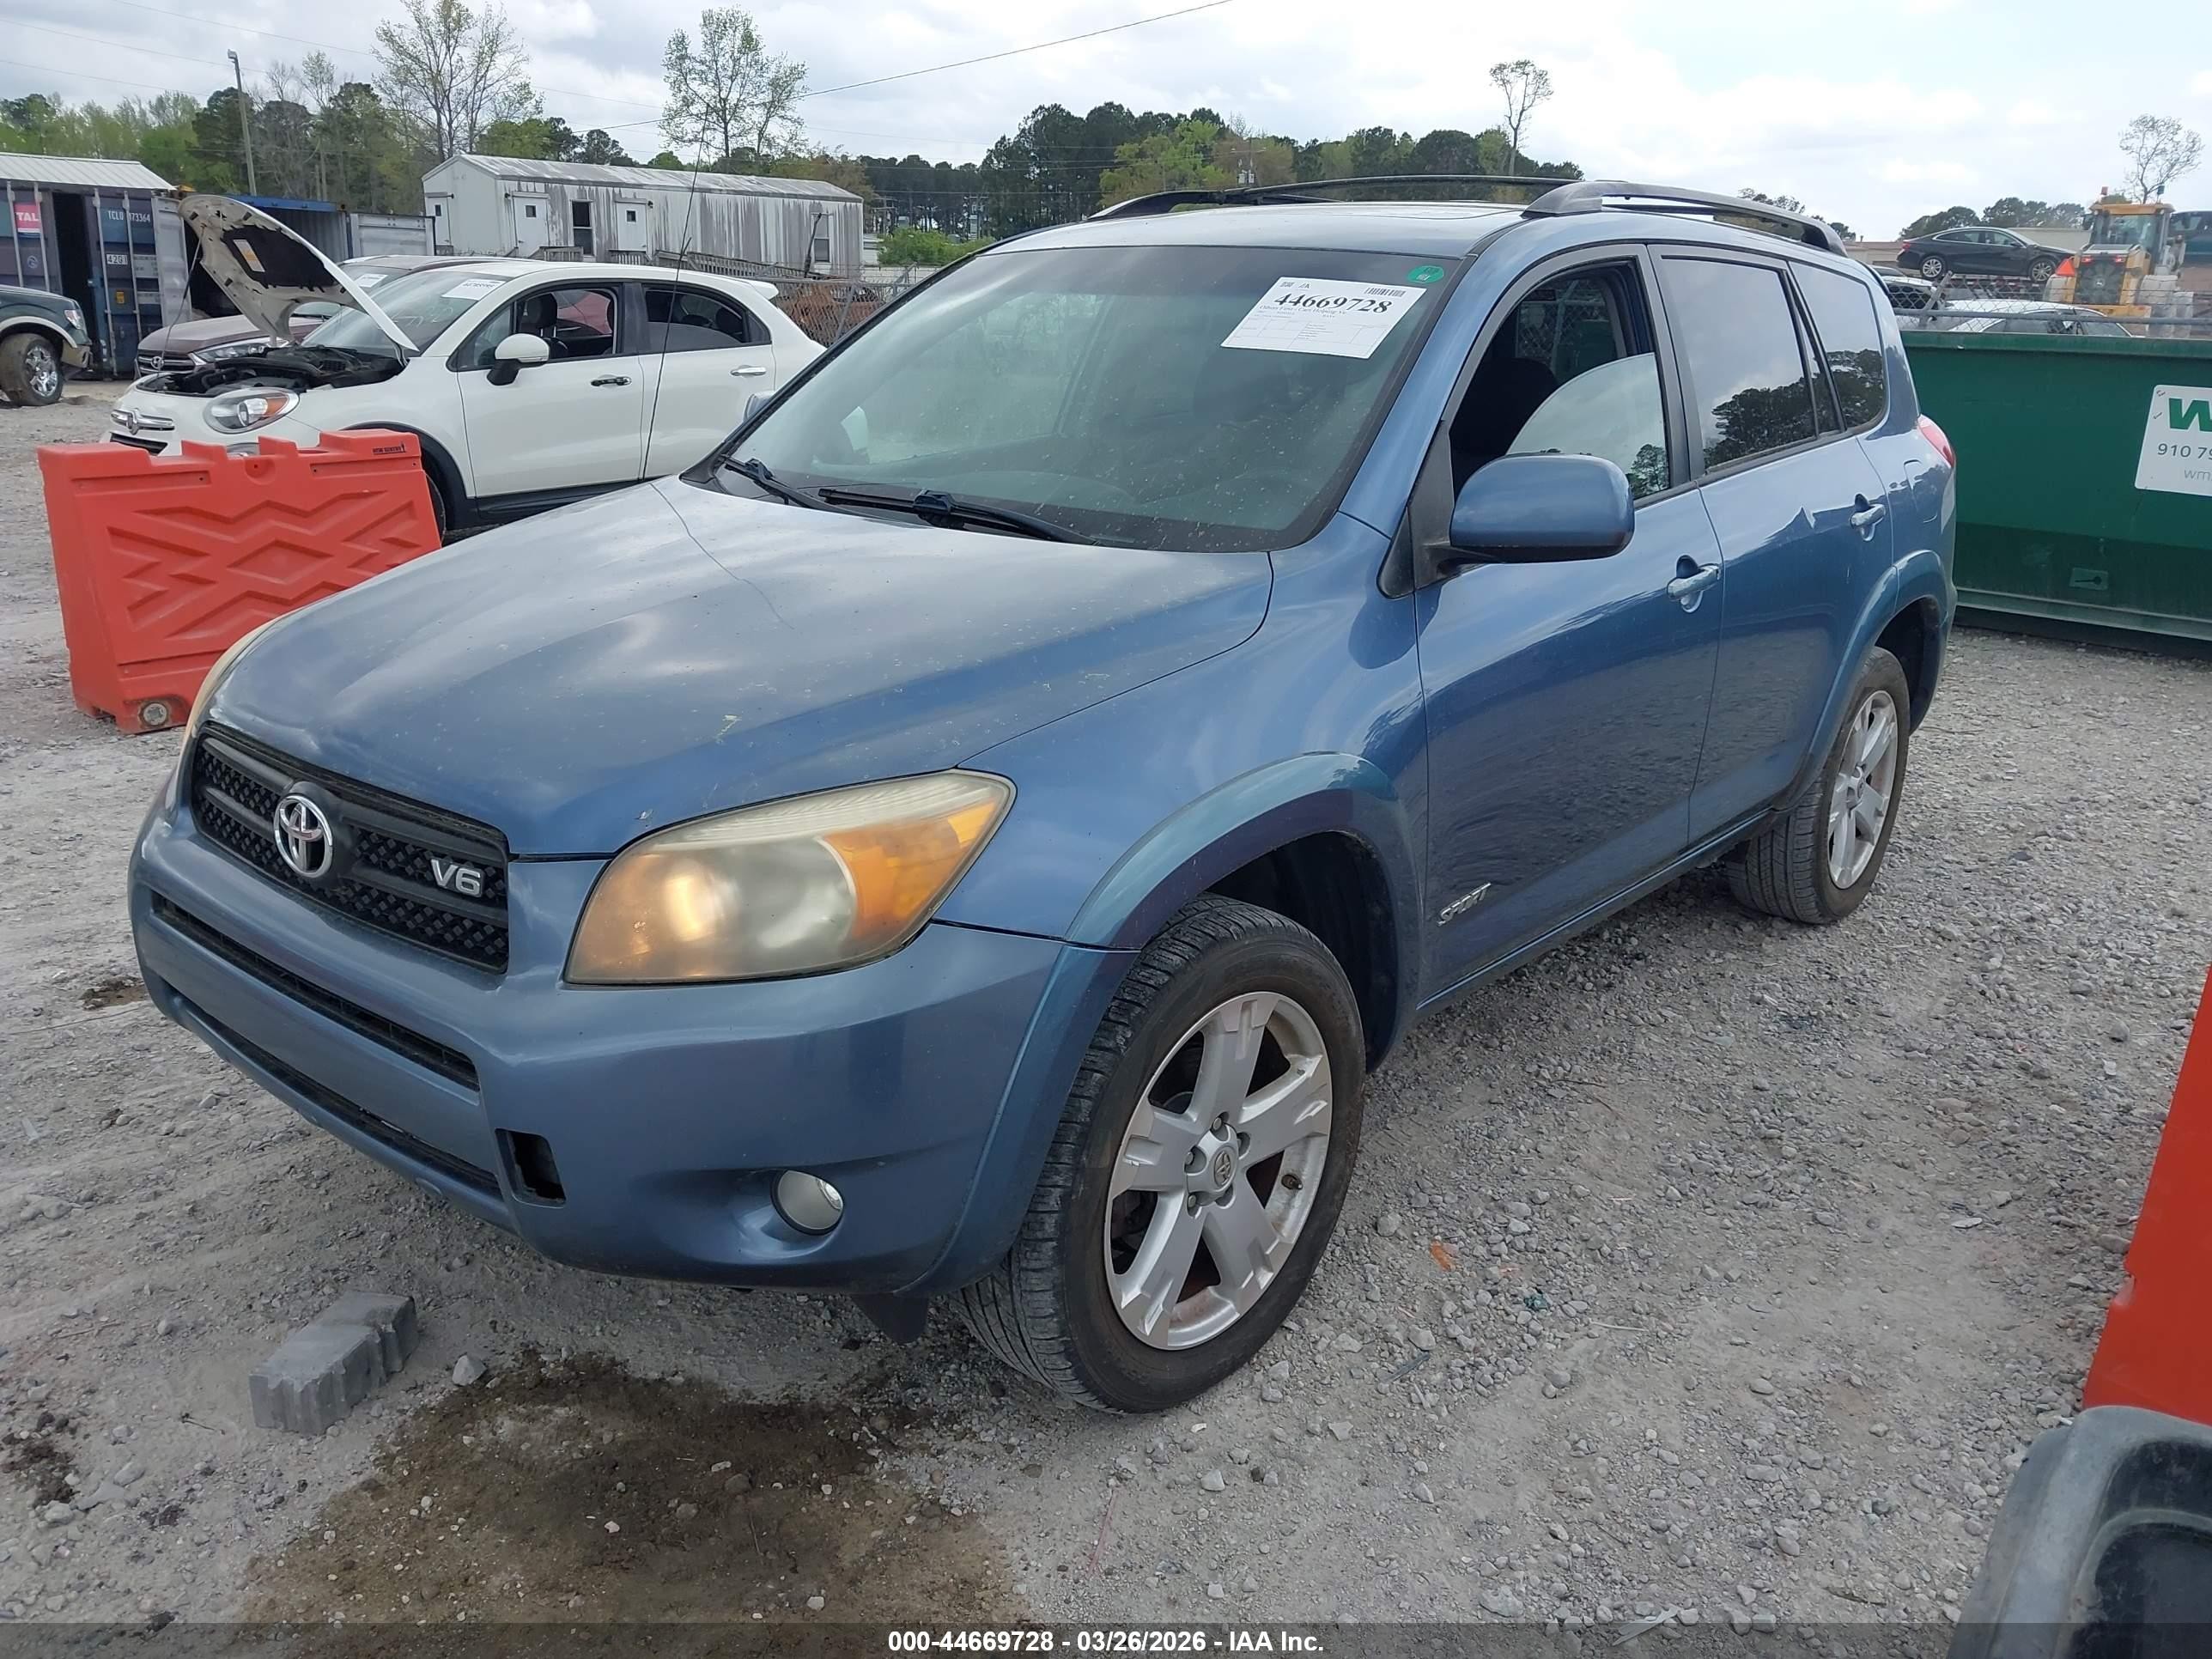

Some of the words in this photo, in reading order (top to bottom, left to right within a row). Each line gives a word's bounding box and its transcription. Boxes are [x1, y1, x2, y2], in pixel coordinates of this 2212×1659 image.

[15, 211, 40, 222] TAL
[1274, 293, 1393, 313] 44669728
[2157, 443, 2191, 458] 910
[431, 858, 483, 898] V6
